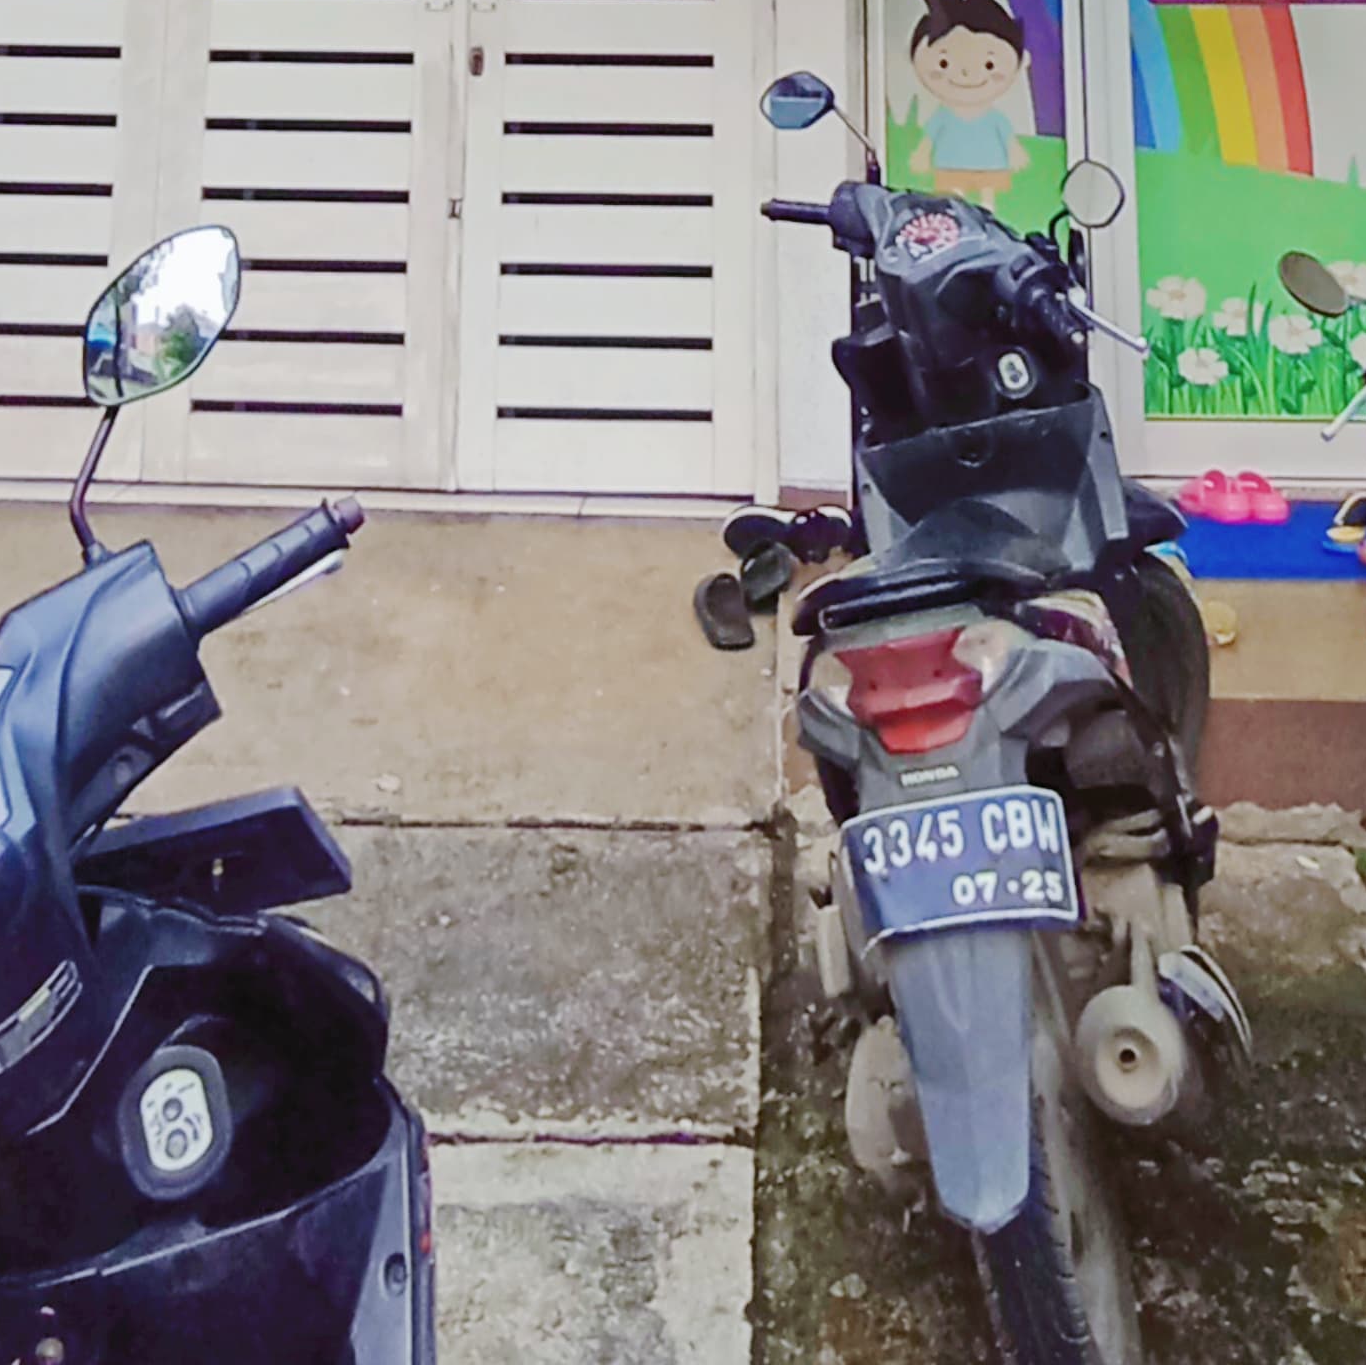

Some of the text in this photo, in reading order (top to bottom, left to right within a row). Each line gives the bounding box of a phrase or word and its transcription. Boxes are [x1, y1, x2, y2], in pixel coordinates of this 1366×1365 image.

[900, 765, 960, 787] HONDA
[863, 799, 1060, 876] 3345 CBW
